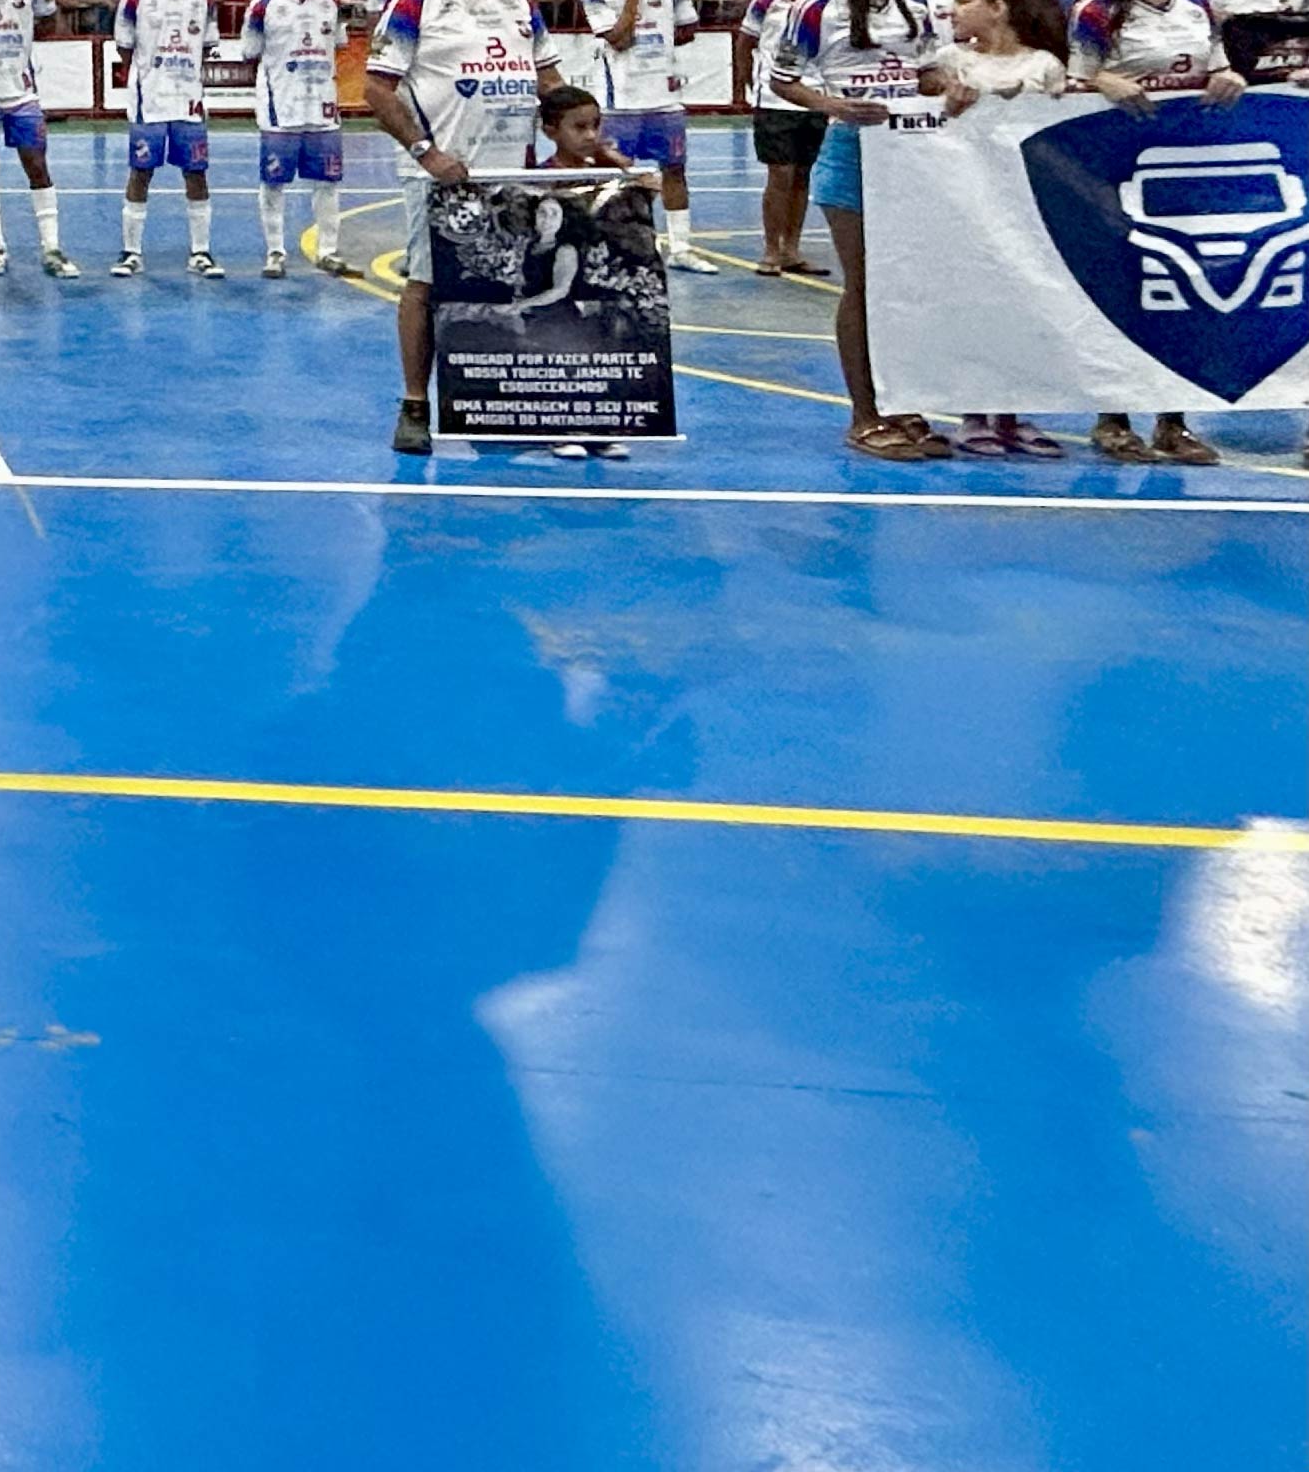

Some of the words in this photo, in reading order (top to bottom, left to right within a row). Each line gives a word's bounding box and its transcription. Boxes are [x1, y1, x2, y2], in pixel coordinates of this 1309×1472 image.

[448, 353, 514, 366] OBRIGADO
[517, 353, 544, 365] POR
[547, 353, 589, 366] FAZER
[592, 352, 635, 365] PARTE
[638, 352, 658, 365] DA
[464, 366, 508, 379] NOSSA
[574, 366, 623, 379] JAMAIS
[626, 366, 643, 379] TE
[453, 399, 482, 412] UMA
[485, 399, 569, 413] HOMENAGEM
[573, 400, 592, 413] DO
[595, 400, 622, 413] SEU
[465, 412, 516, 425] AMIGOS
